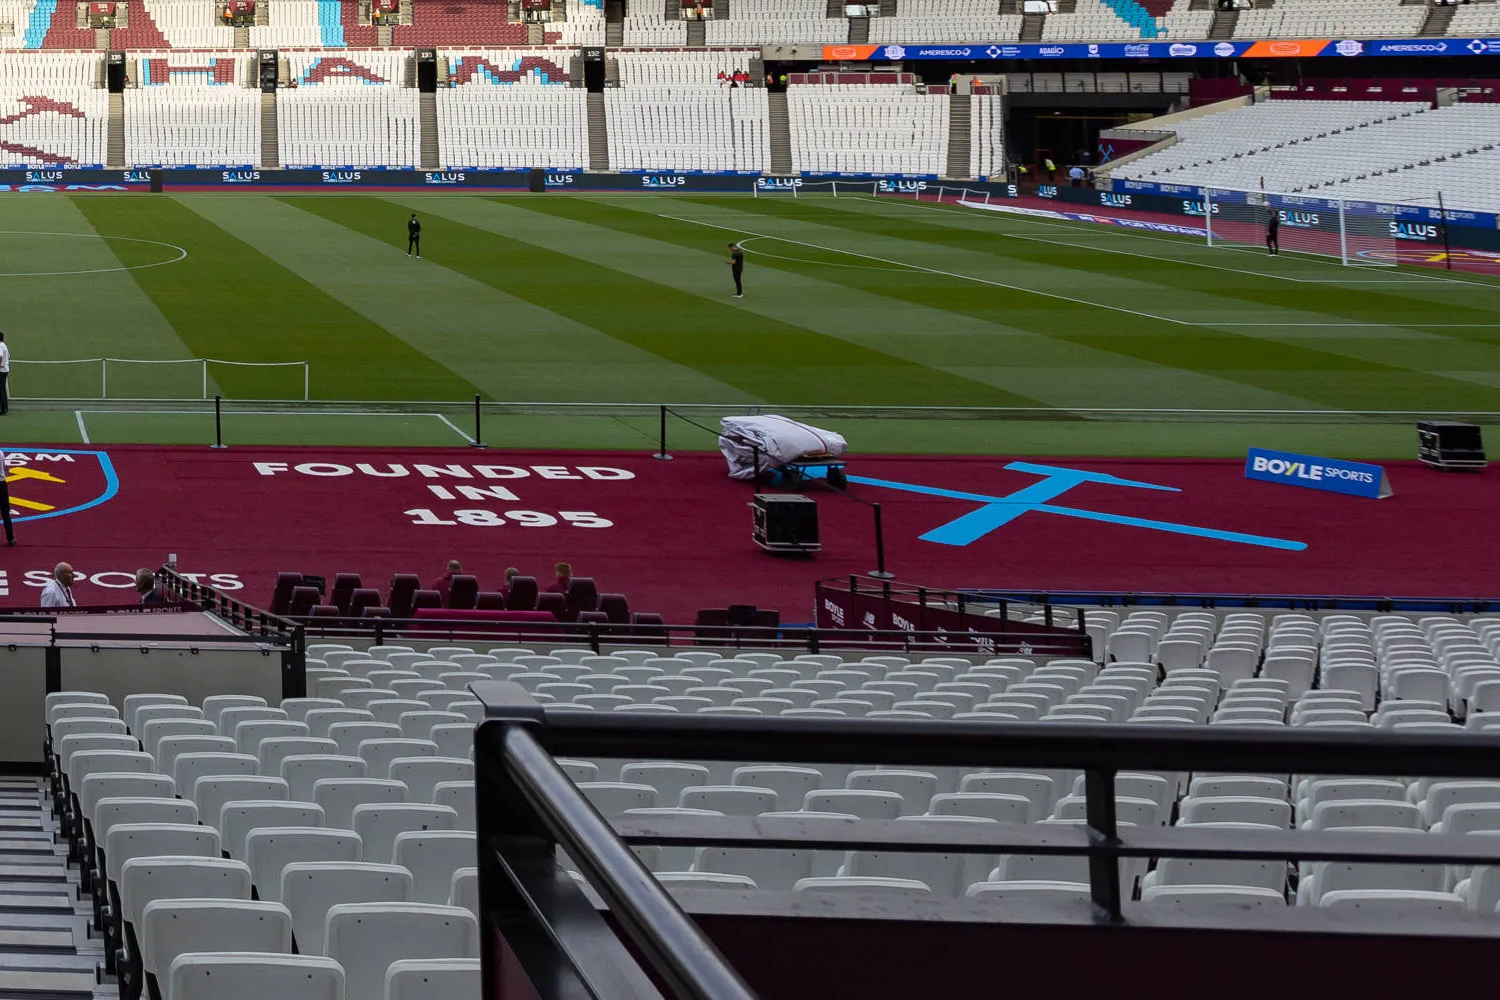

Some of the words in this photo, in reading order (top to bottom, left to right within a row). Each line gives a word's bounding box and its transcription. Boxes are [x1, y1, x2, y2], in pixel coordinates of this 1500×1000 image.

[919, 48, 962, 56] AMERESCO
[26, 171, 62, 179] SALUS
[223, 171, 260, 179] SALUS
[323, 171, 361, 180] SALUS
[426, 173, 465, 181] SALUS
[642, 176, 685, 184] SALUS
[758, 178, 803, 187] SALUS
[879, 180, 927, 190] SALUS
[1100, 192, 1132, 204] SALUS
[1279, 210, 1320, 224] SALUS
[1389, 221, 1437, 237] SALUS
[253, 461, 636, 480] FOUNDED
[1253, 456, 1324, 481] BOYLE
[1324, 467, 1374, 483] SPORTS
[426, 485, 521, 502] IN
[404, 509, 614, 529] 1895
[825, 598, 845, 619] BOYLE
[893, 613, 916, 633] BOYLE
